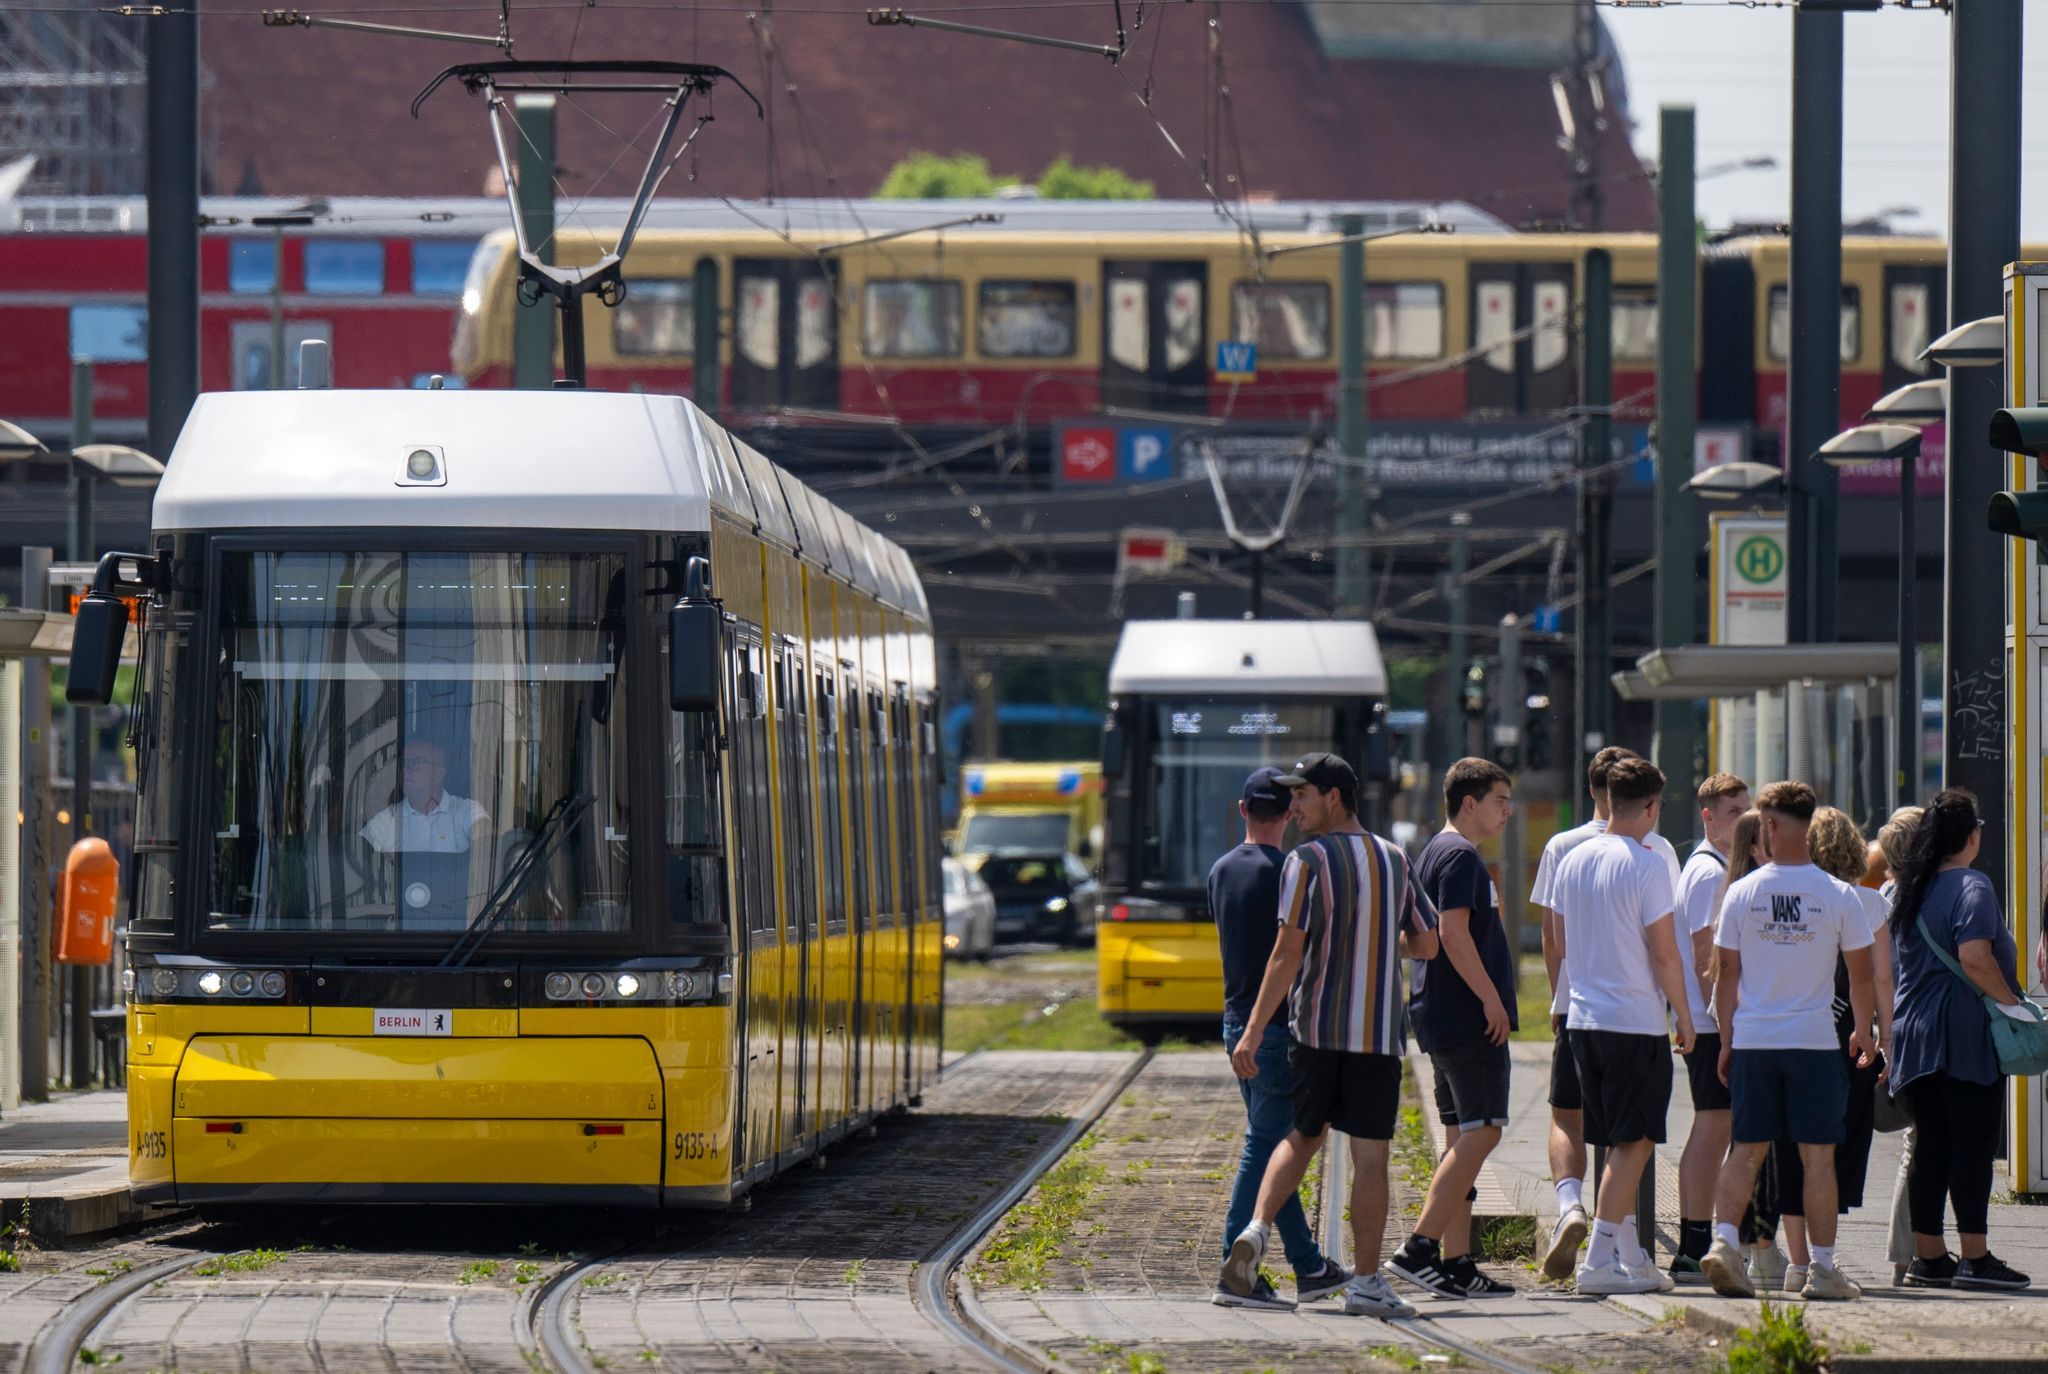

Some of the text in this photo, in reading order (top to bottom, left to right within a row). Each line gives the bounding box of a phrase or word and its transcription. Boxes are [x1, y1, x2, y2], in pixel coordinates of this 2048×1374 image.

[1133, 435, 1161, 473] P
[1750, 548, 1770, 571] H
[1771, 895, 1801, 923] VANS
[379, 1016, 421, 1027] BERLIN
[136, 1130, 166, 1158] A-9135
[674, 1132, 718, 1160] 9135-A
